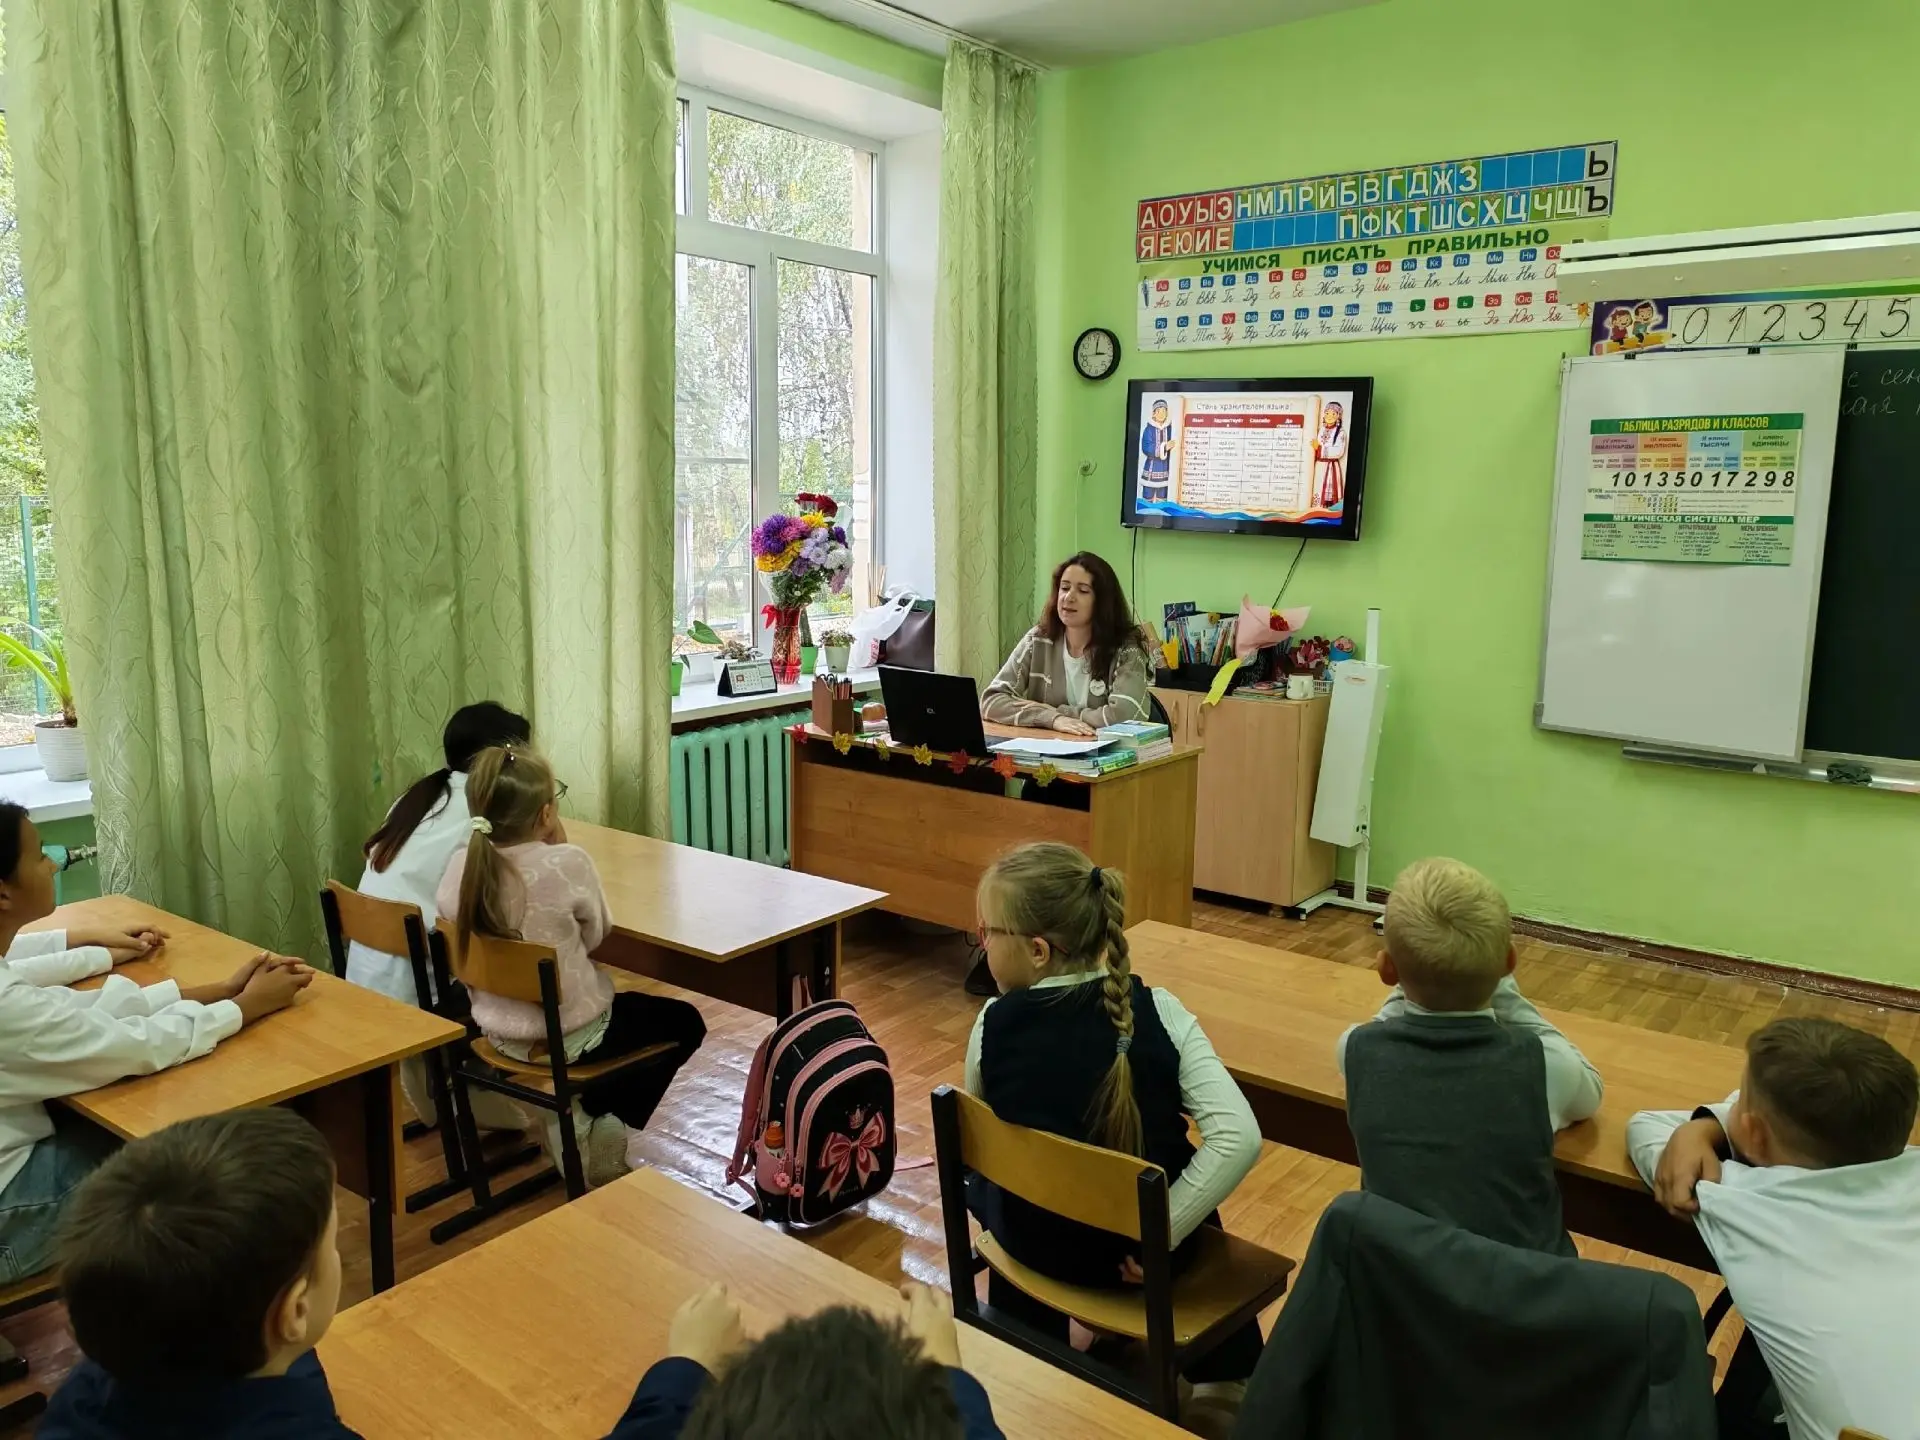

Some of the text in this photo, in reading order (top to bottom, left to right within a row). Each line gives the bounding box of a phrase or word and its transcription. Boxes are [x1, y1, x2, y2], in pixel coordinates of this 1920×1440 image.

[1203, 228, 1550, 273] УЧИМСЯ ПИСАТЬ ПРАВИЛЬНО
[1682, 296, 1912, 345] 0 1 2 3 4 5
[1619, 416, 1769, 433] ТАБЛИЦА РАЗРЯДОВ И КЛАССОВ
[1613, 515, 1682, 523] МЕТРИЧЕСКАЯ
[1737, 516, 1760, 524] МЕР
